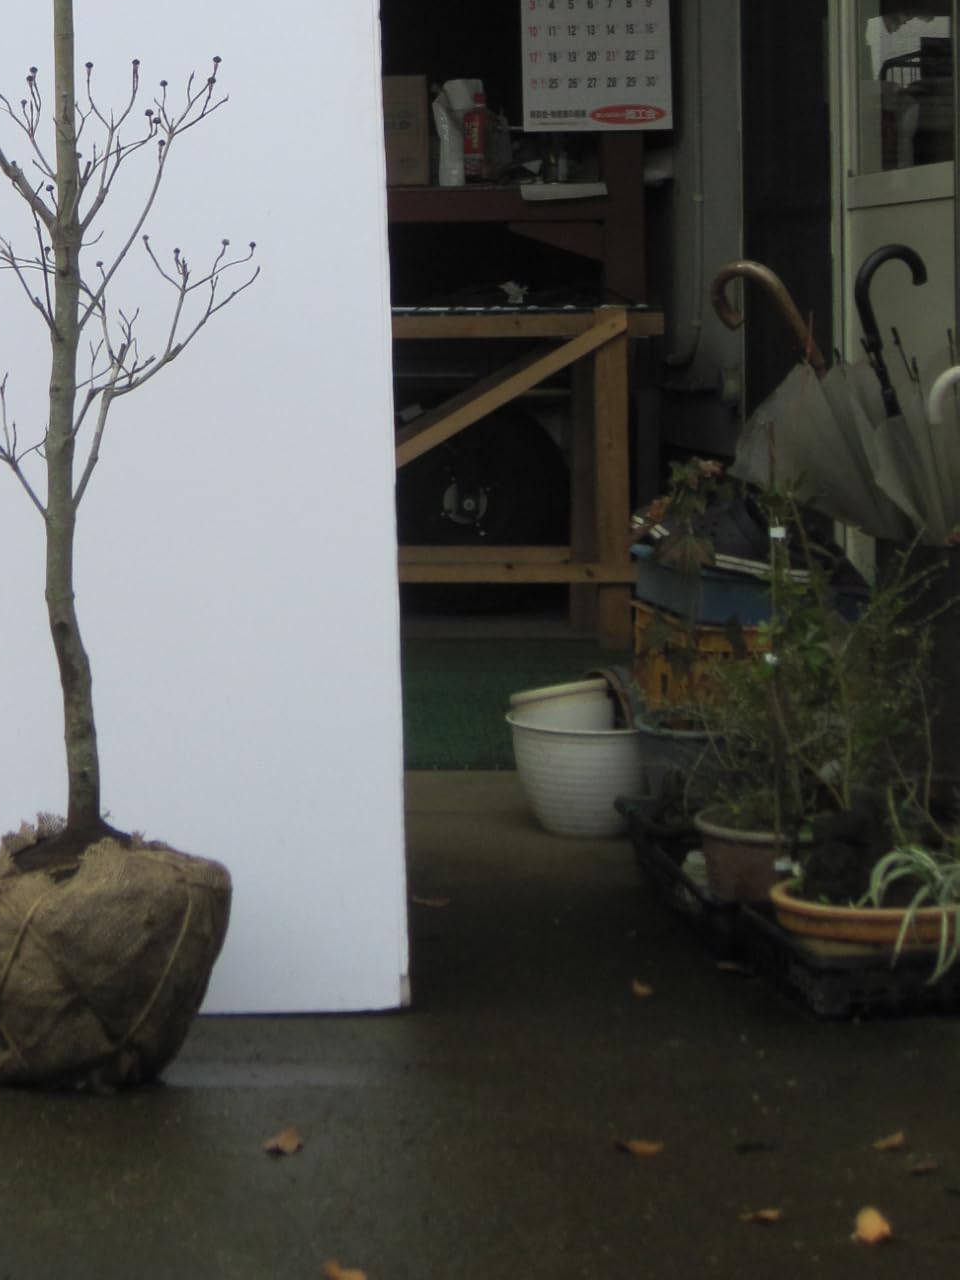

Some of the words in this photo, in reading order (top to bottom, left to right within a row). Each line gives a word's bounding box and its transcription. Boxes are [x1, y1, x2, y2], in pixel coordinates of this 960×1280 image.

[529, 1, 535, 10] 3
[549, 0, 555, 9] 4
[568, 0, 574, 9] 5
[588, 0, 593, 8] 6
[608, 0, 613, 8] 7
[529, 27, 538, 37] 10
[549, 26, 556, 36] 11
[568, 26, 576, 36] 12
[606, 25, 615, 35] 14
[626, 24, 634, 34] 15
[530, 53, 538, 62] 17
[587, 52, 596, 62] 20
[606, 51, 615, 61] 21
[549, 79, 558, 88] 25
[568, 78, 578, 88] 26
[587, 78, 596, 88] 27
